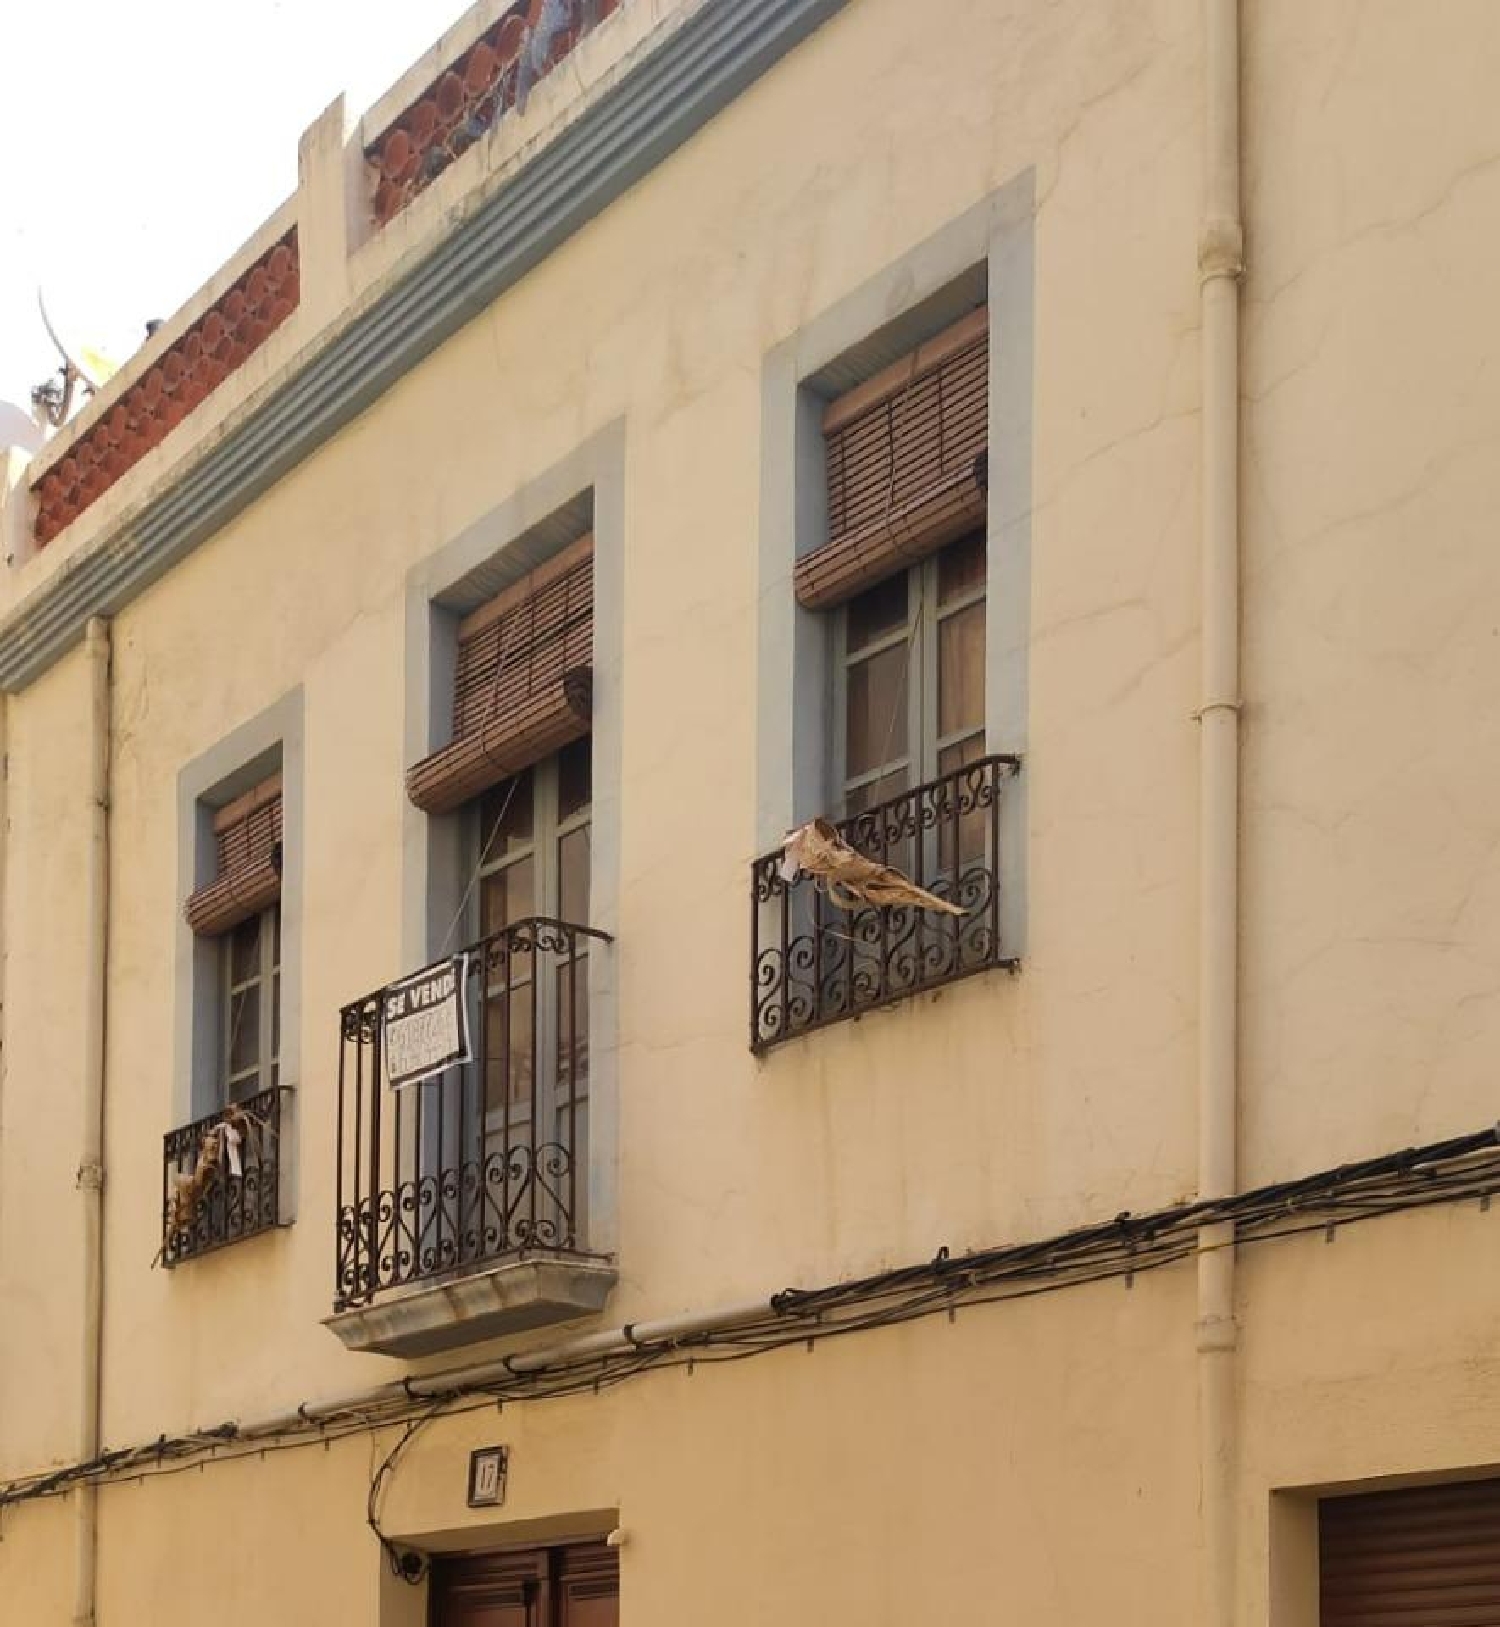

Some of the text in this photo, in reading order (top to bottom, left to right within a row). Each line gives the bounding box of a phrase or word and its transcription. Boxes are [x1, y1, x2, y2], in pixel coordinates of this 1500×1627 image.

[387, 974, 455, 1019] SE VEND
[480, 1463, 495, 1490] 17
